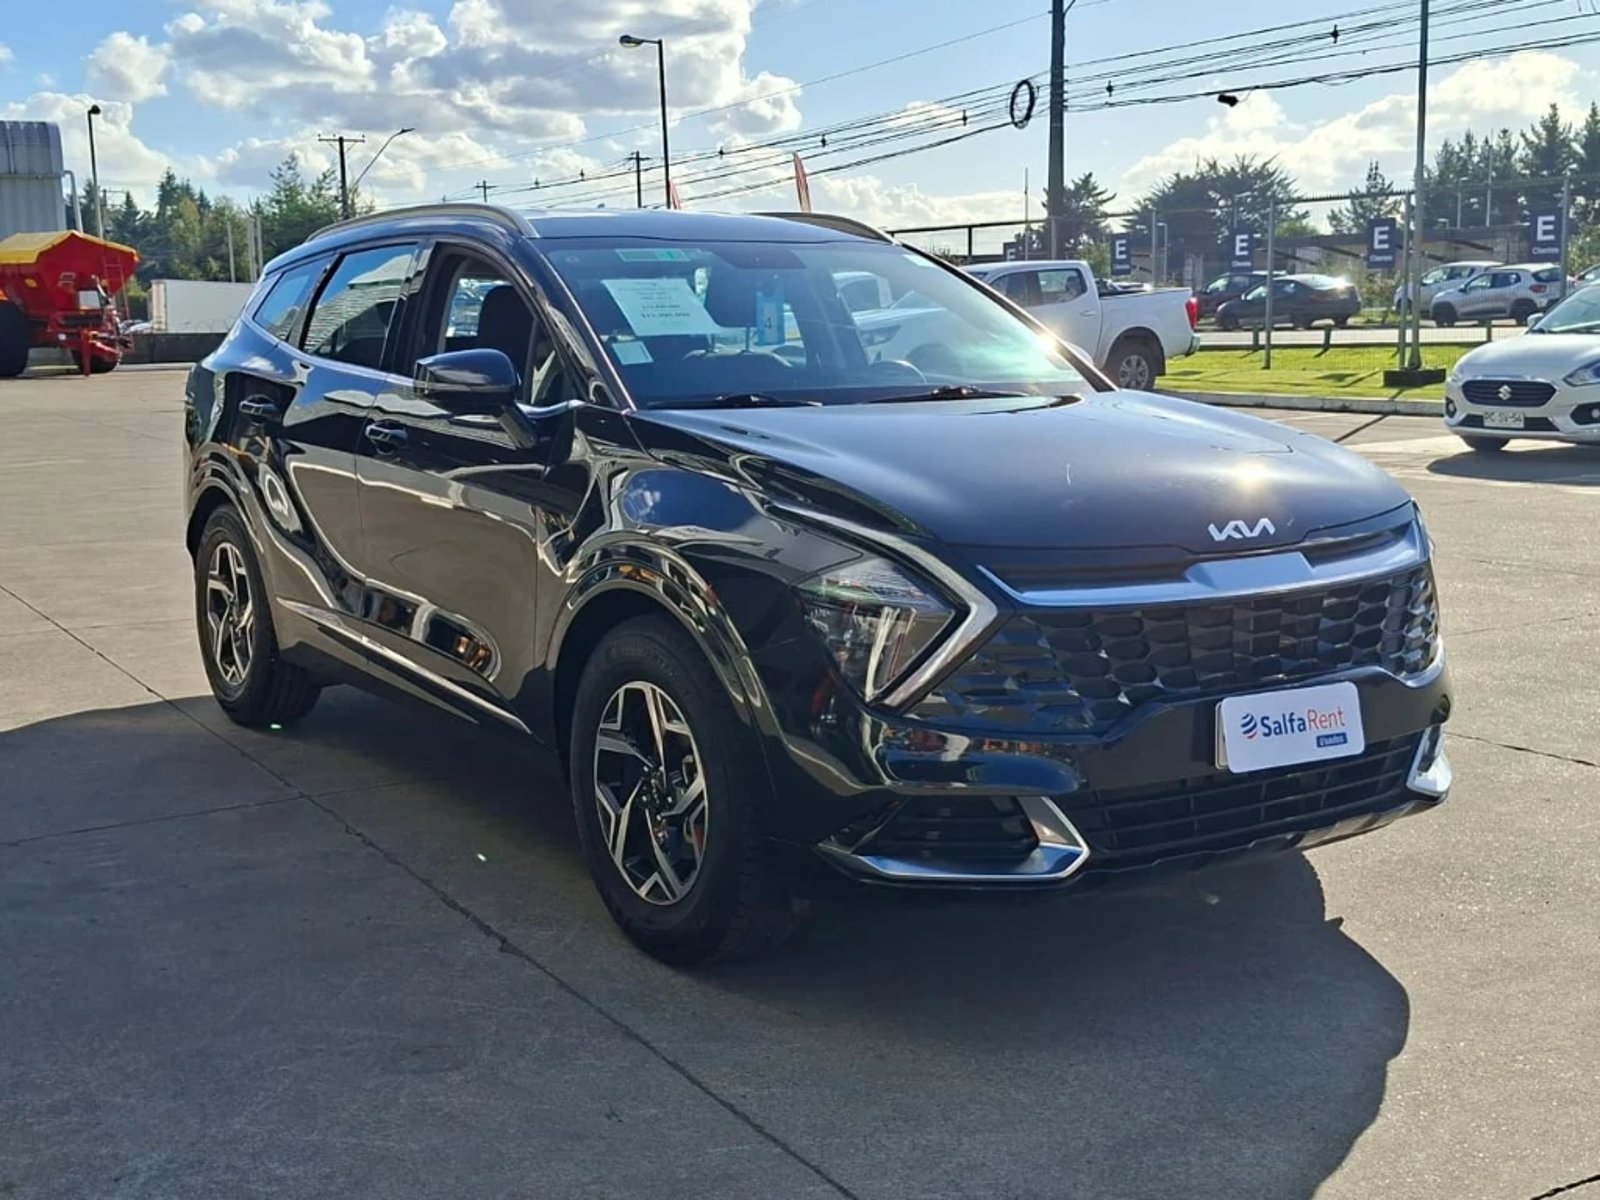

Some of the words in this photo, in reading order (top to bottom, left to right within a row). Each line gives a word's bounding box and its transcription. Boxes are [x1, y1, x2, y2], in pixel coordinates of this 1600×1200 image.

[1373, 226, 1390, 249] E
[1537, 215, 1555, 241] E
[1115, 239, 1127, 259] E
[1235, 234, 1249, 256] E
[1208, 517, 1276, 541] KIA
[1260, 708, 1345, 737] SalfaRent
